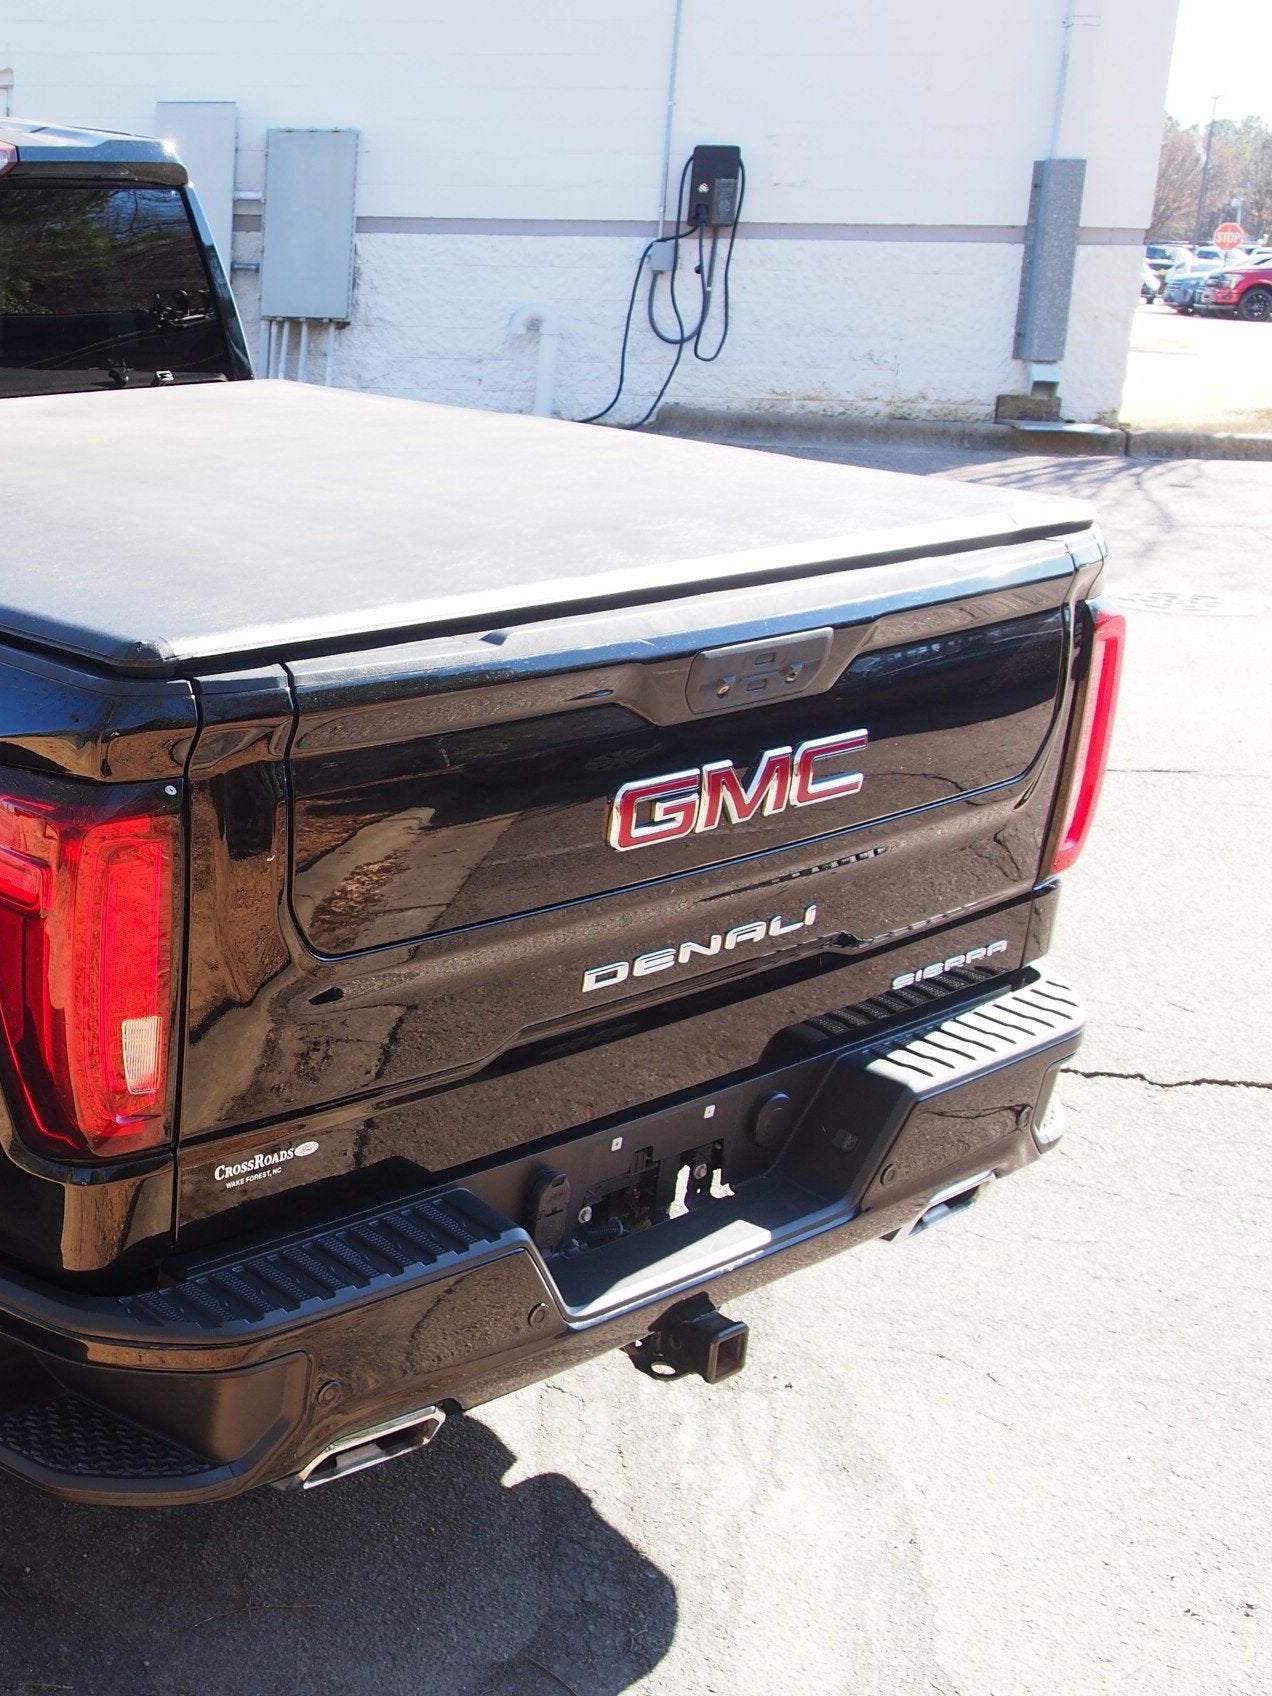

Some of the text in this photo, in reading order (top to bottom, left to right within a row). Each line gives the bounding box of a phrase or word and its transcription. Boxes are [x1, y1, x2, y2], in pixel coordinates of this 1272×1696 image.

[1216, 231, 1241, 243] STOP
[607, 728, 869, 852] GMC
[581, 904, 818, 993] DENALI
[891, 940, 1008, 990] SIERRA
[226, 1166, 282, 1189] WAKE FOREST, NC
